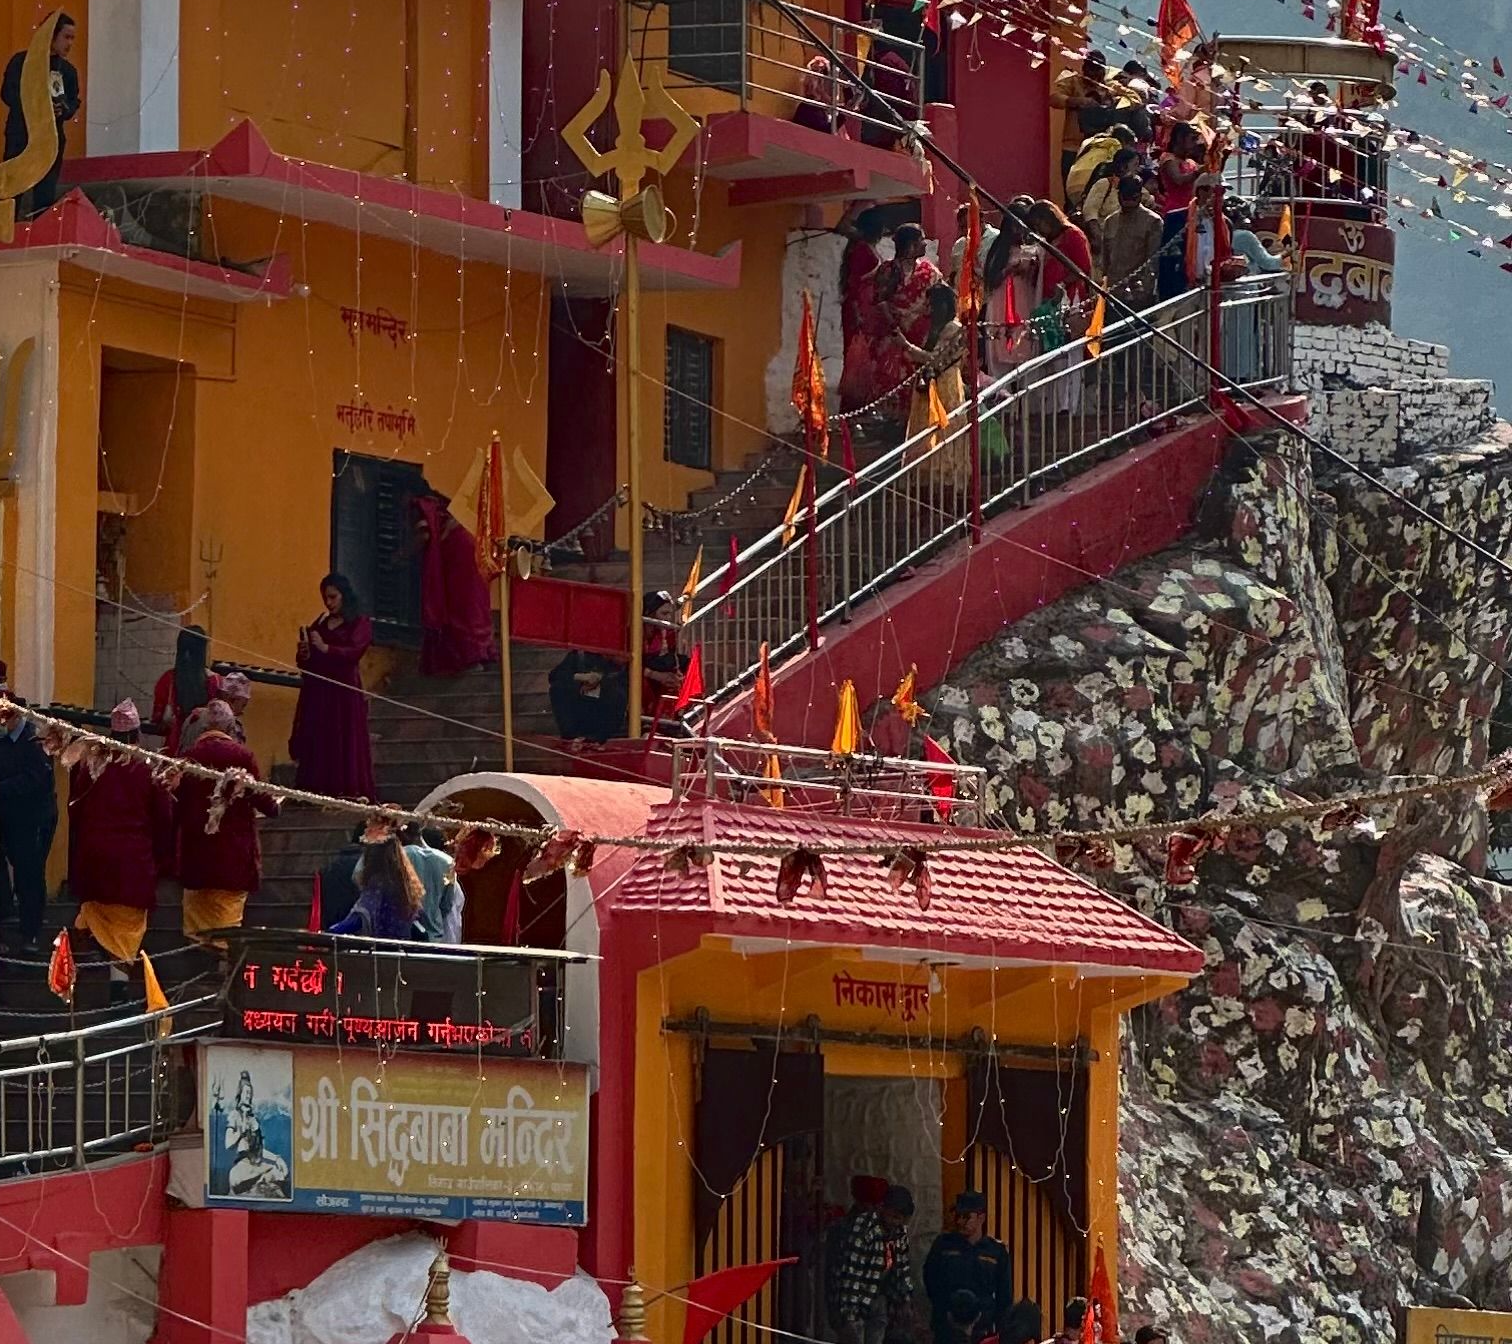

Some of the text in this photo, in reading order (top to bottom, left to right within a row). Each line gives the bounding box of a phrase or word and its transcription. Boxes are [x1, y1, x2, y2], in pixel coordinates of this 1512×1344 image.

[833, 969, 897, 1017] निकास
[300, 1076, 579, 1187] श्री सिद्धबाबा मन्दिर
